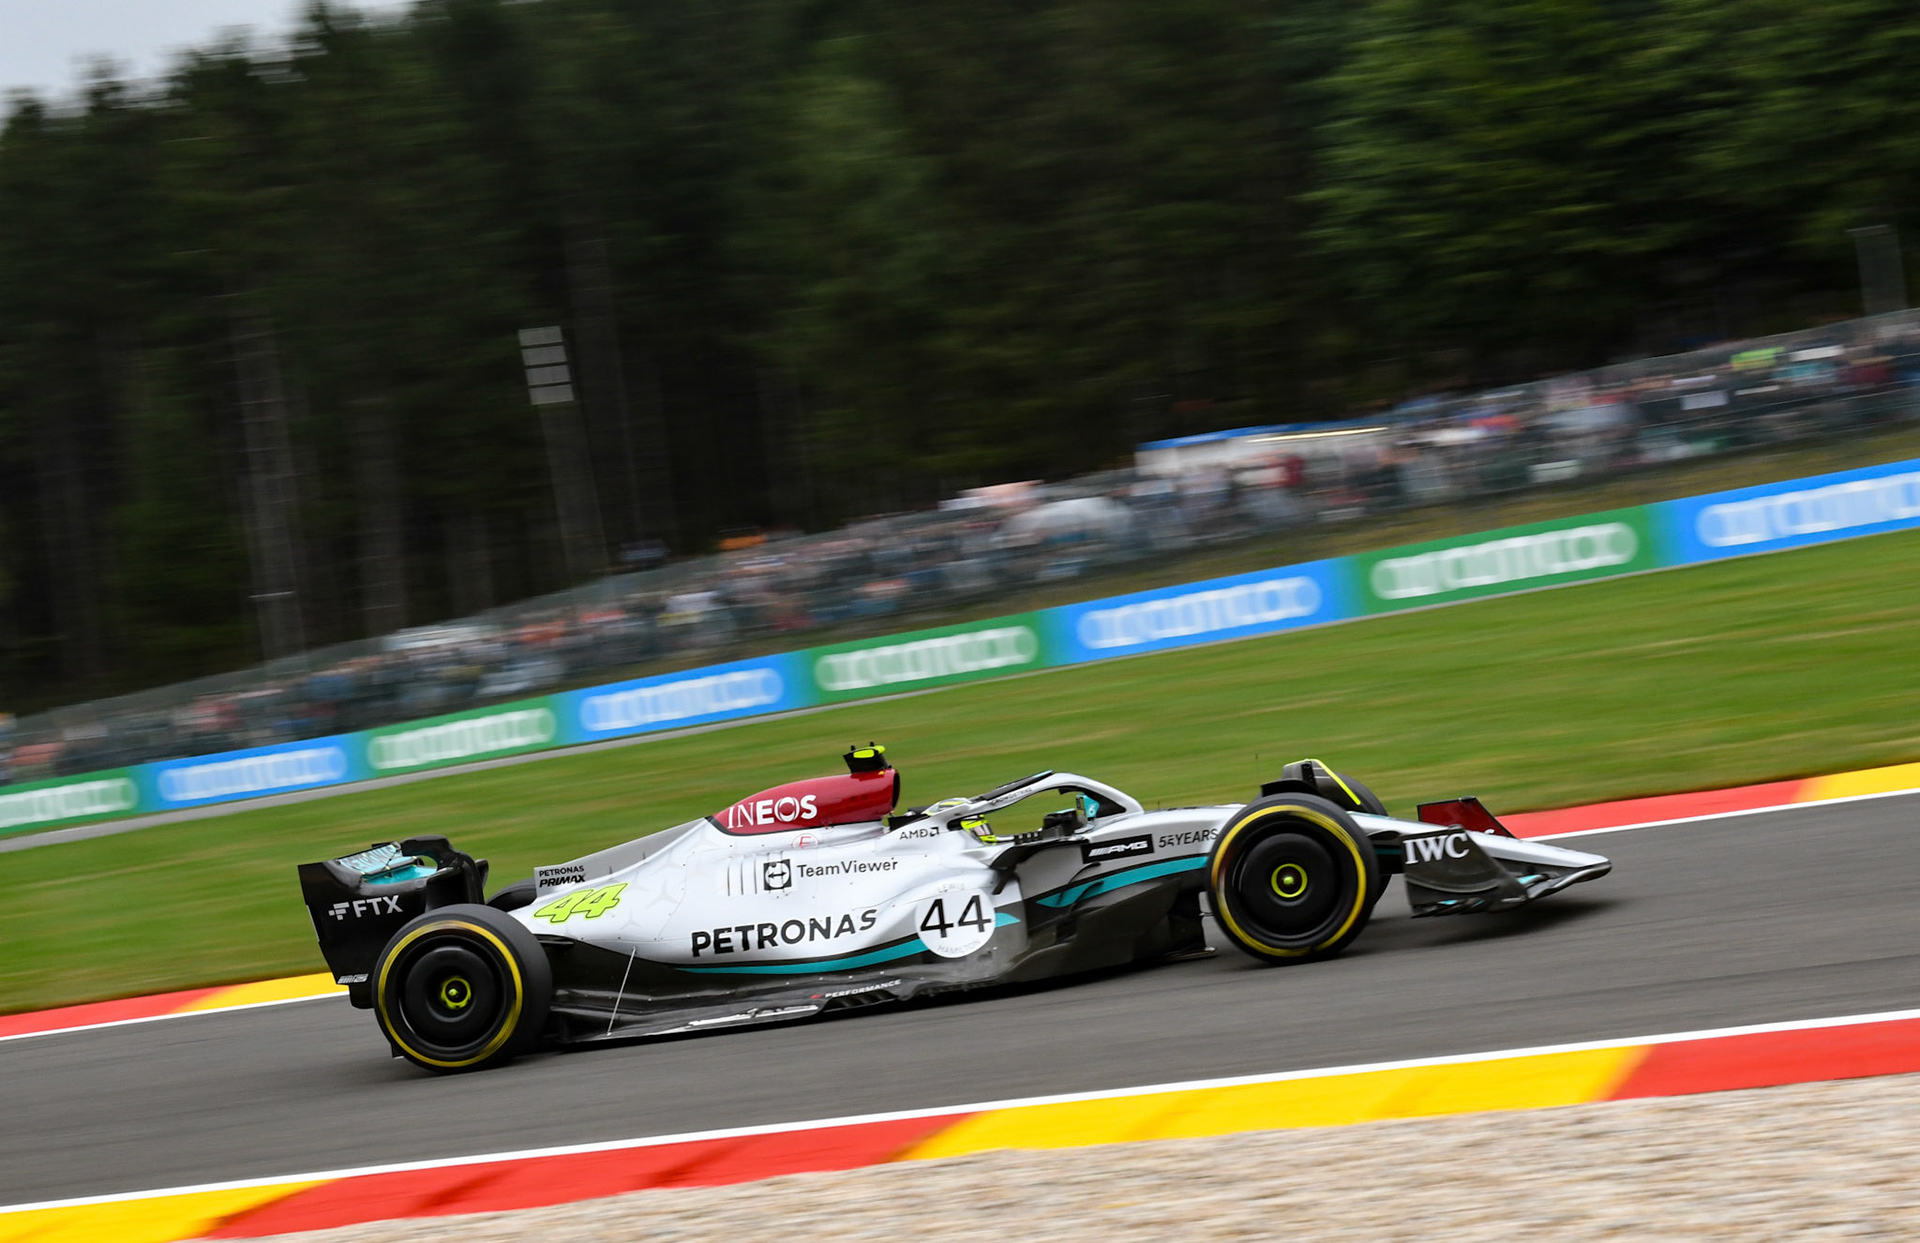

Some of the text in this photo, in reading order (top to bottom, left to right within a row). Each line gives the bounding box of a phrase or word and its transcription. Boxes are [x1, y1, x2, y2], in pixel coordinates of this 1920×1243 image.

[727, 795, 817, 828] INEOS
[900, 829, 929, 839] AMD
[1106, 841, 1149, 854] AMG
[1402, 833, 1469, 864] IWC
[539, 865, 585, 877] PETRONAS
[797, 859, 898, 878] TeamViewer
[539, 874, 585, 888] PRIMAX
[353, 895, 403, 918] FTX
[533, 882, 628, 923] 44
[920, 895, 992, 938] 44
[691, 909, 877, 957] PETRONAS
[825, 979, 901, 998] PERFORMANCE
